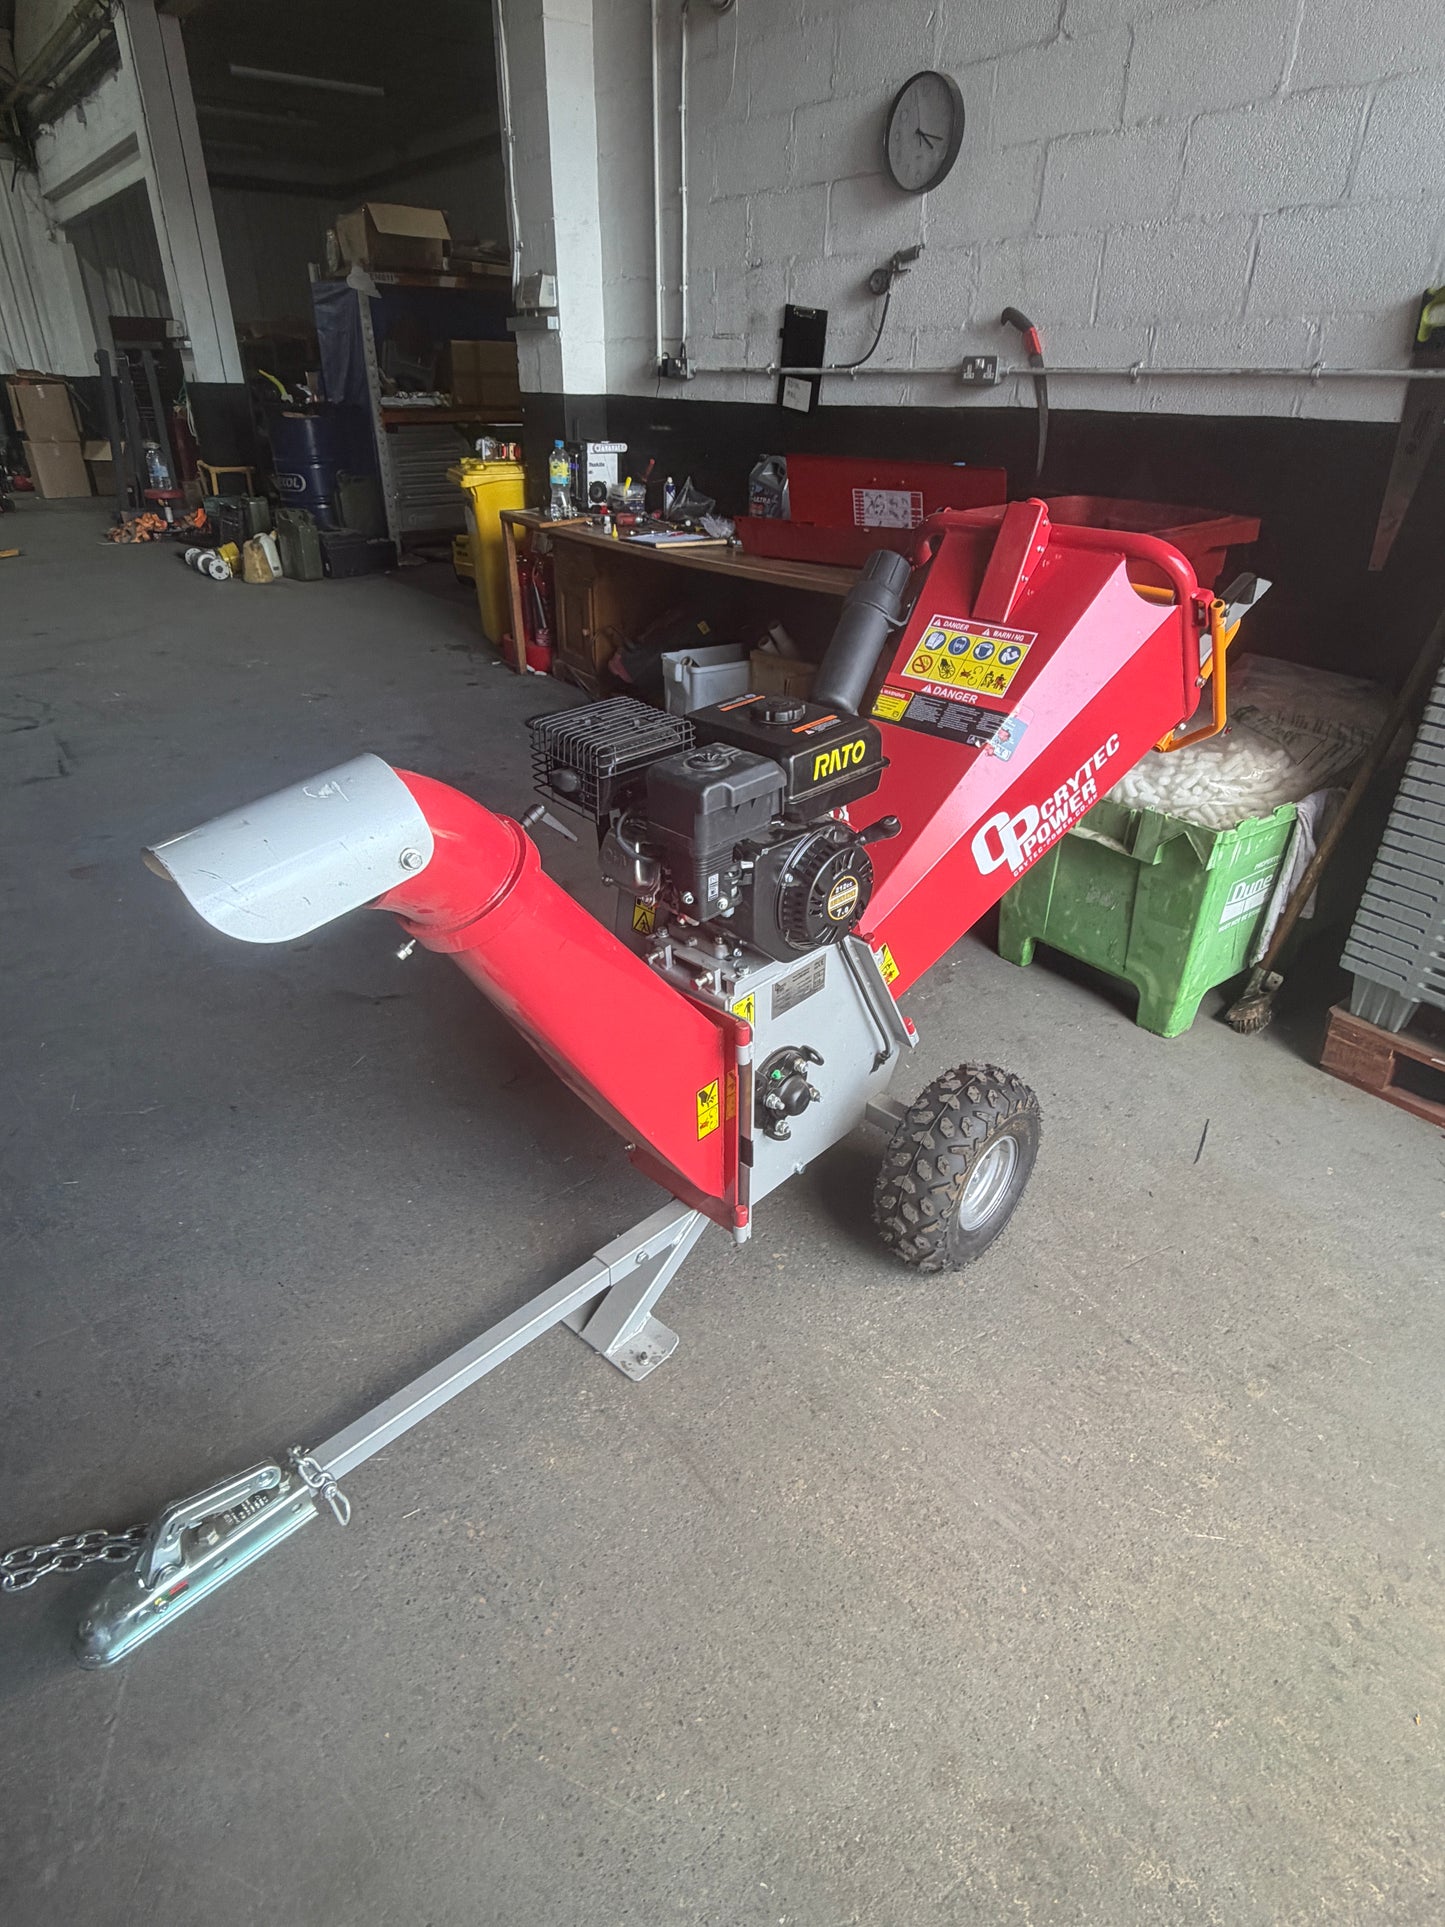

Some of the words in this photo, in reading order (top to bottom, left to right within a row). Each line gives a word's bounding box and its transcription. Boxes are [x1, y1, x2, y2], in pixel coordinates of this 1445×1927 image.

[942, 620, 969, 631] DANGER
[992, 630, 1025, 642] WARNING
[932, 686, 978, 704] DANGER
[813, 739, 866, 781] RATO
[1040, 733, 1120, 820] CRYTEC
[1022, 777, 1097, 858] POWER
[835, 881, 853, 893] 212cc
[836, 906, 849, 917] 7.0
